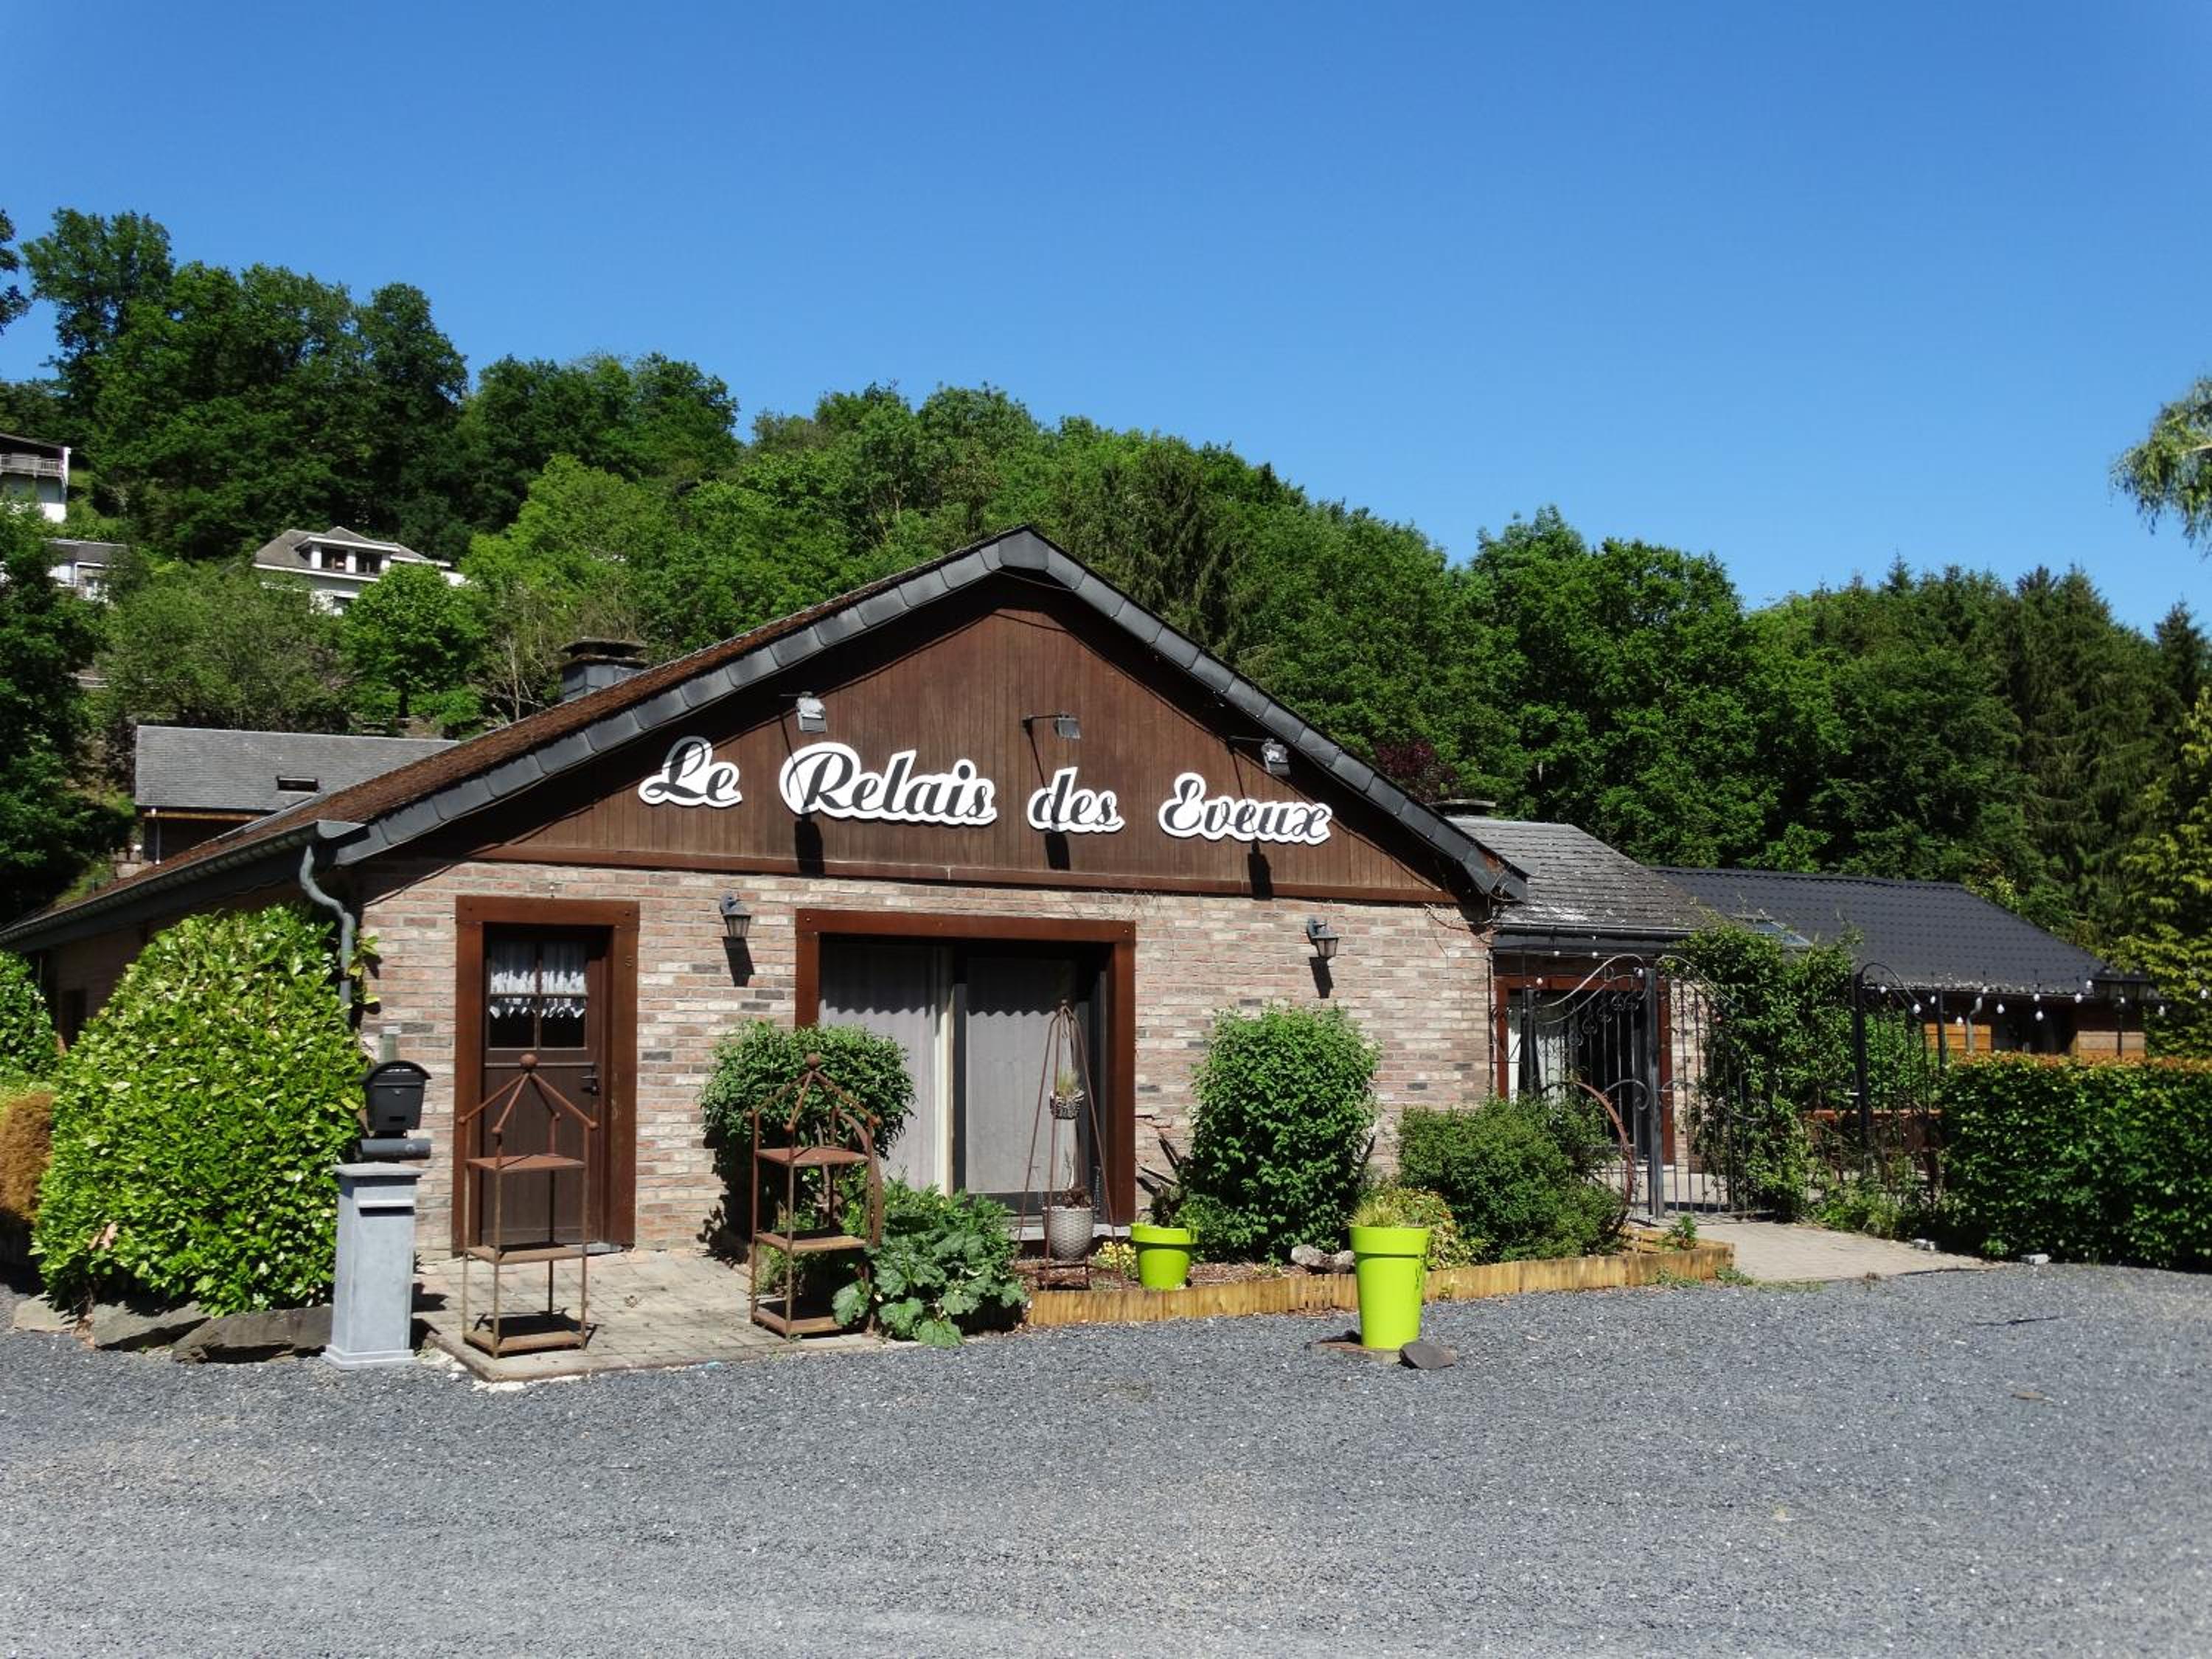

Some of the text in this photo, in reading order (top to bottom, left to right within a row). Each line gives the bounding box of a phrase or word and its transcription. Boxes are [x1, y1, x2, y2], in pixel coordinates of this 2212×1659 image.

[644, 739, 1329, 839] Le Relais des Eveux
